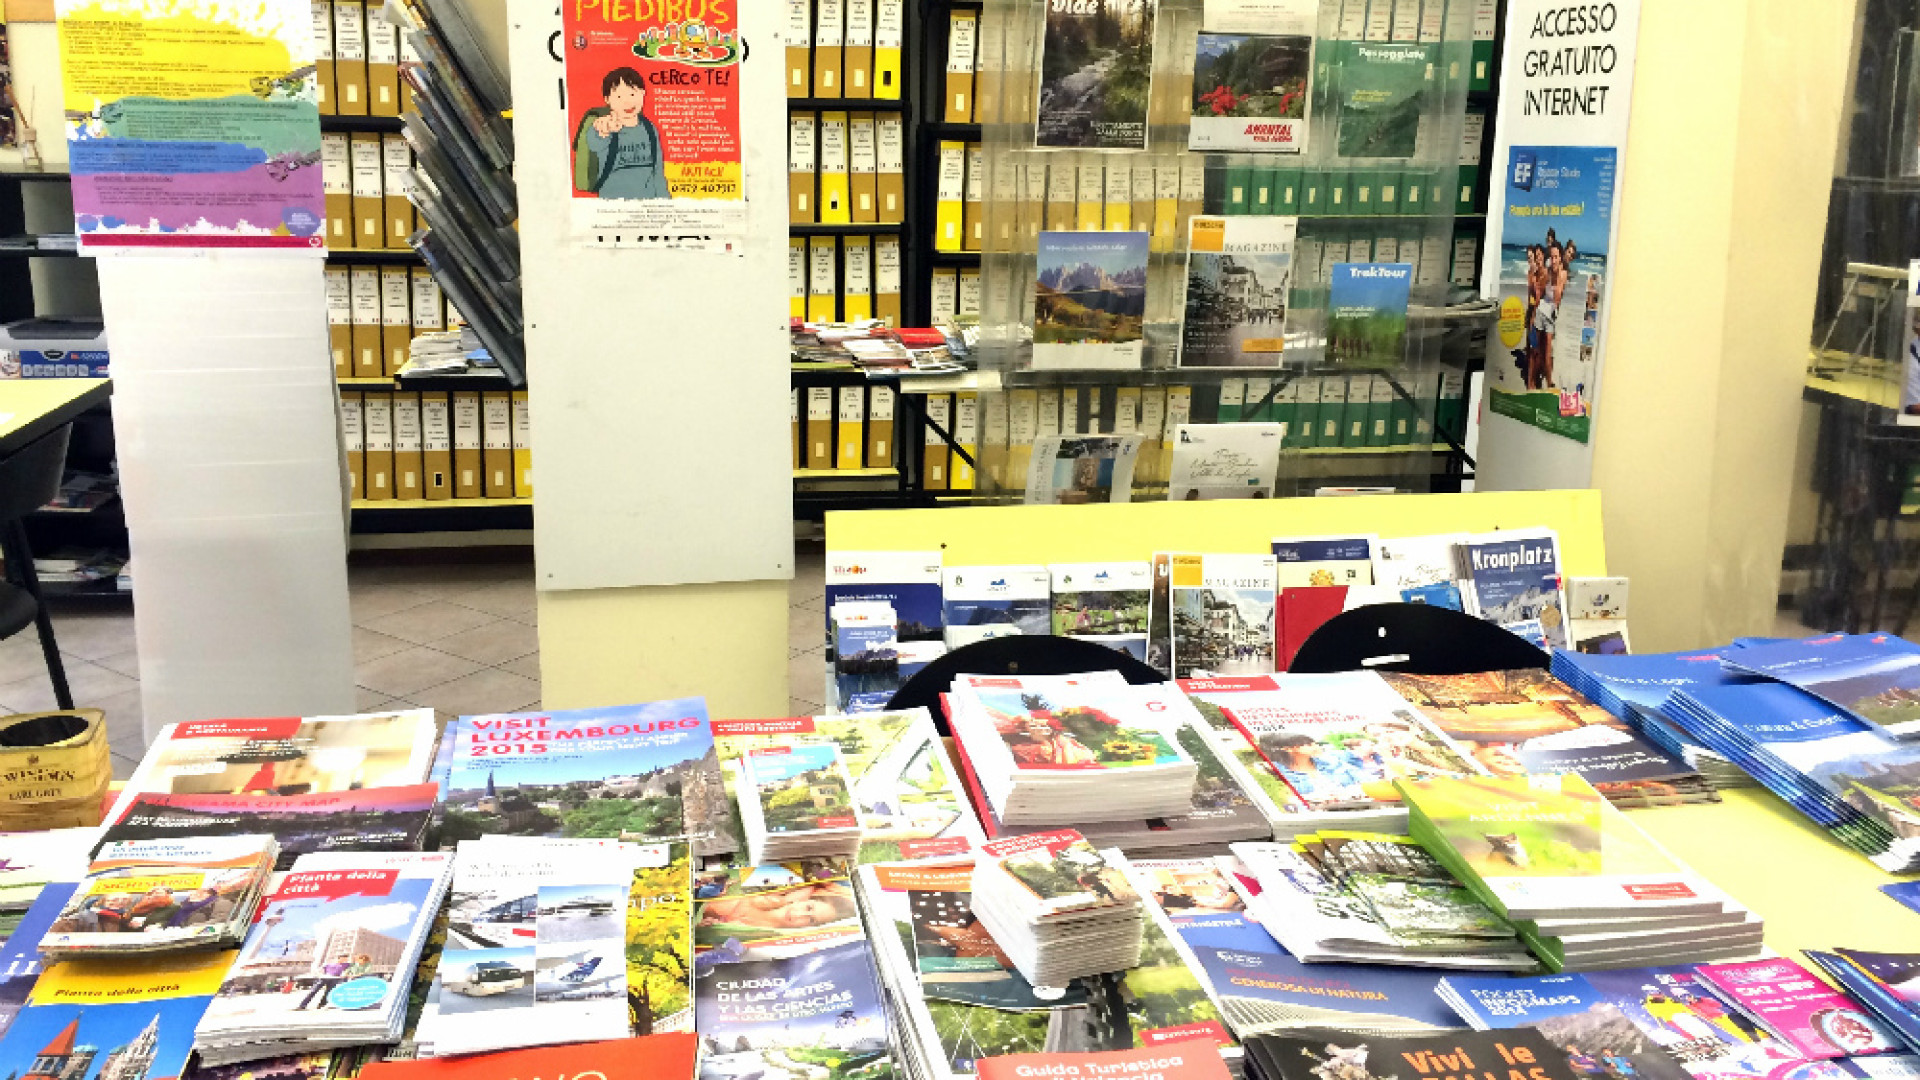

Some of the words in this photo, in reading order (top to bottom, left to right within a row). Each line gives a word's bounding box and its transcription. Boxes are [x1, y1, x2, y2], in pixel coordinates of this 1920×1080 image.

[1530, 2, 1617, 38] ACCESSO
[1524, 44, 1617, 77] GRATUITO
[649, 69, 701, 86] CERCO
[1524, 86, 1609, 116] INTERNET
[1514, 162, 1532, 183] EF
[1225, 243, 1288, 252] MAGAZINE
[1472, 544, 1553, 573] Kronplatz
[471, 716, 551, 730] VISIT
[471, 717, 702, 744] LUXEMBOURG
[470, 743, 547, 757] 2015
[716, 977, 786, 991] CIUDAD
[717, 993, 740, 1002] DE
[745, 991, 778, 1002] LAS
[783, 979, 836, 999] ARTES
[719, 1005, 729, 1014] Y
[772, 989, 854, 1013] CIENCIAS
[1015, 1061, 1080, 1077] Guida
[1083, 1056, 1183, 1075] Turistica
[1400, 1045, 1476, 1074] Vivi
[1493, 1042, 1537, 1066] le
